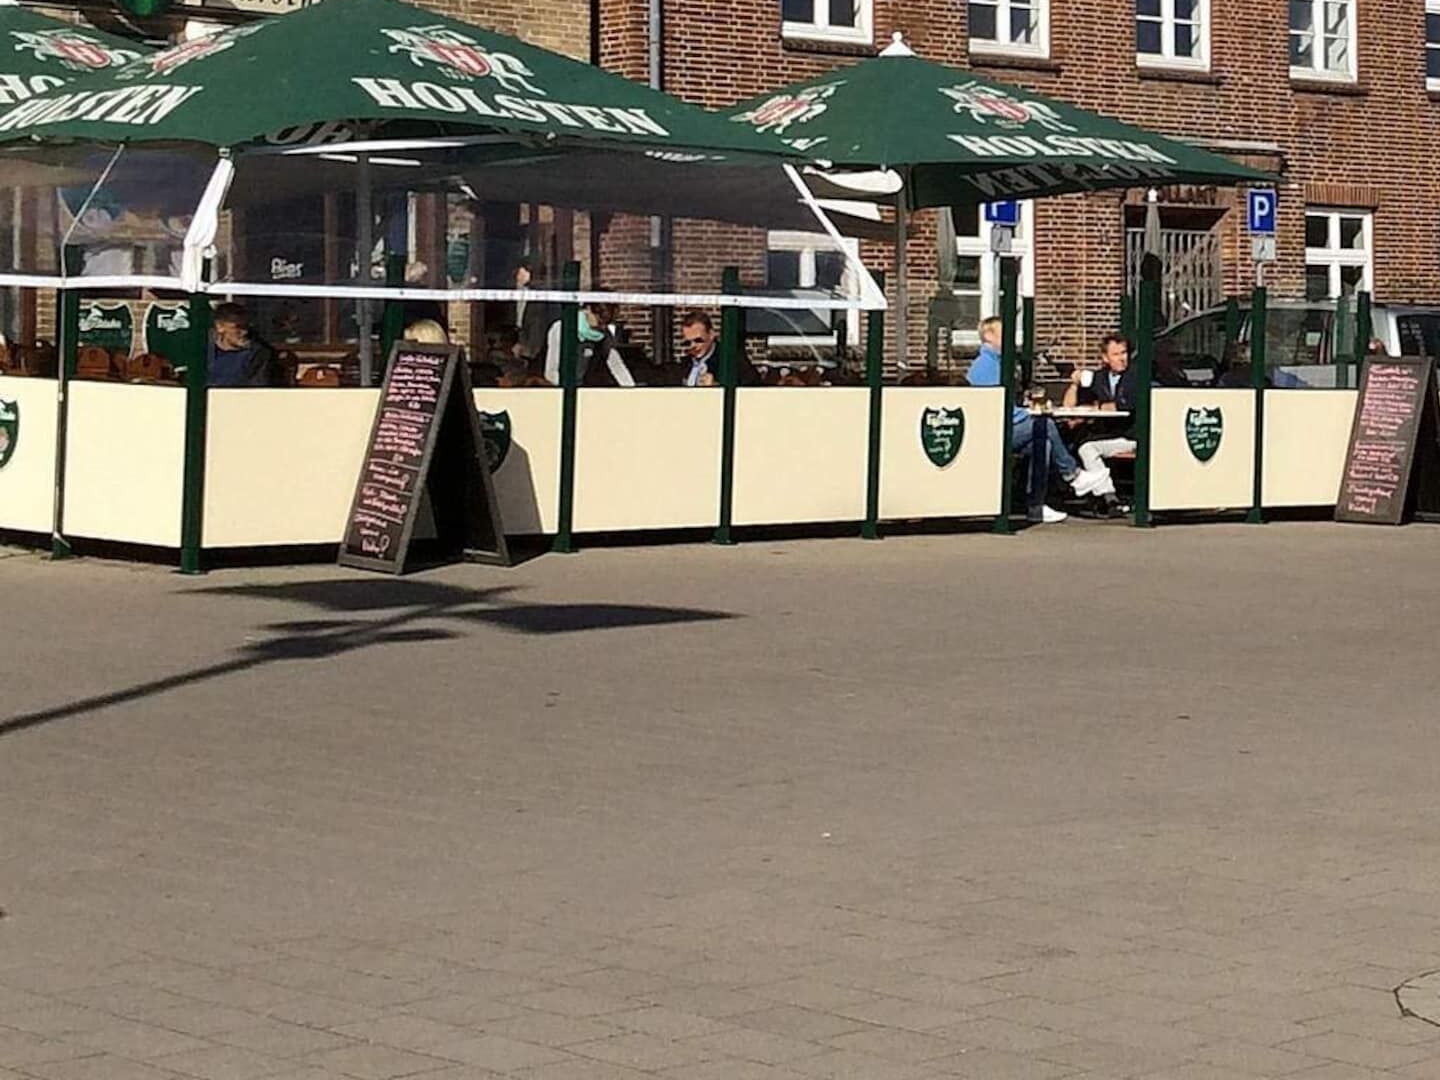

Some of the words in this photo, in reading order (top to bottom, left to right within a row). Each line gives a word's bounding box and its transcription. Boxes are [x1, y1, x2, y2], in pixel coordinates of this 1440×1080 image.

[0, 84, 204, 131] HOLSTEN
[351, 77, 669, 137] HOLSTEN
[946, 134, 1178, 165] HOLSTEN
[1253, 195, 1271, 228] P
